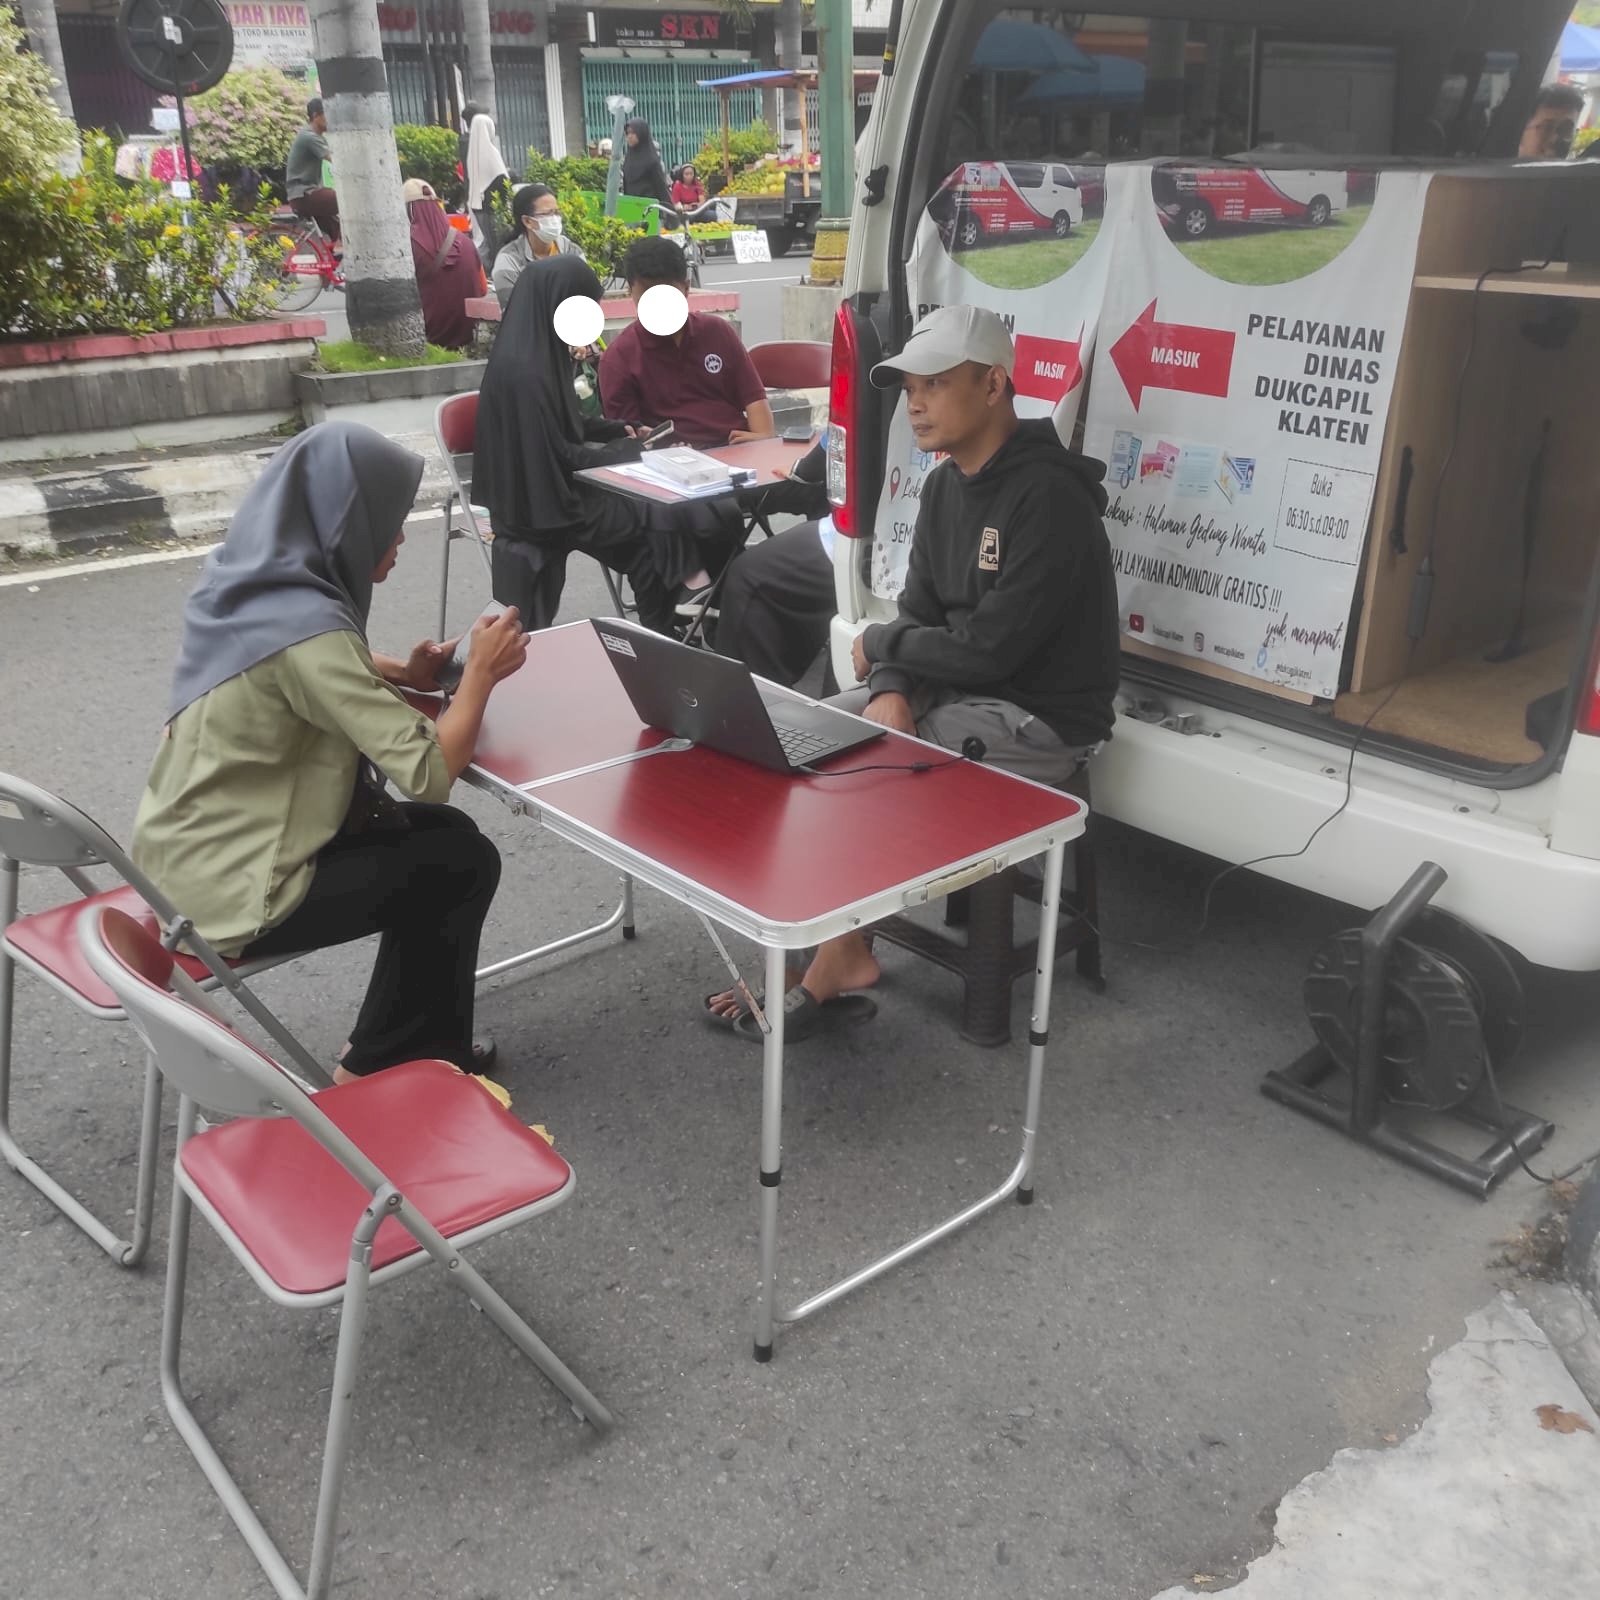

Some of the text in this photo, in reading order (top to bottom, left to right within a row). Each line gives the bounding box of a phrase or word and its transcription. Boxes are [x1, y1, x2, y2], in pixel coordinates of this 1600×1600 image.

[660, 14, 720, 39] SKN
[1247, 313, 1385, 353] PELAYANAN
[1034, 360, 1066, 379] MASUK
[1150, 346, 1201, 369] MASUK
[1303, 352, 1381, 385] DINAS
[1255, 375, 1374, 416] DUKCAPIL
[1277, 409, 1370, 446] KLATEN
[1311, 473, 1333, 497] Buka
[1142, 503, 1187, 536] Halaman
[1187, 513, 1228, 557] Gedung
[1230, 523, 1267, 556] Wanita
[981, 554, 998, 564] FILA
[1124, 552, 1167, 584] LAYANAN
[1167, 563, 1221, 597] ADMINDUK
[1224, 578, 1267, 608] GRATISS
